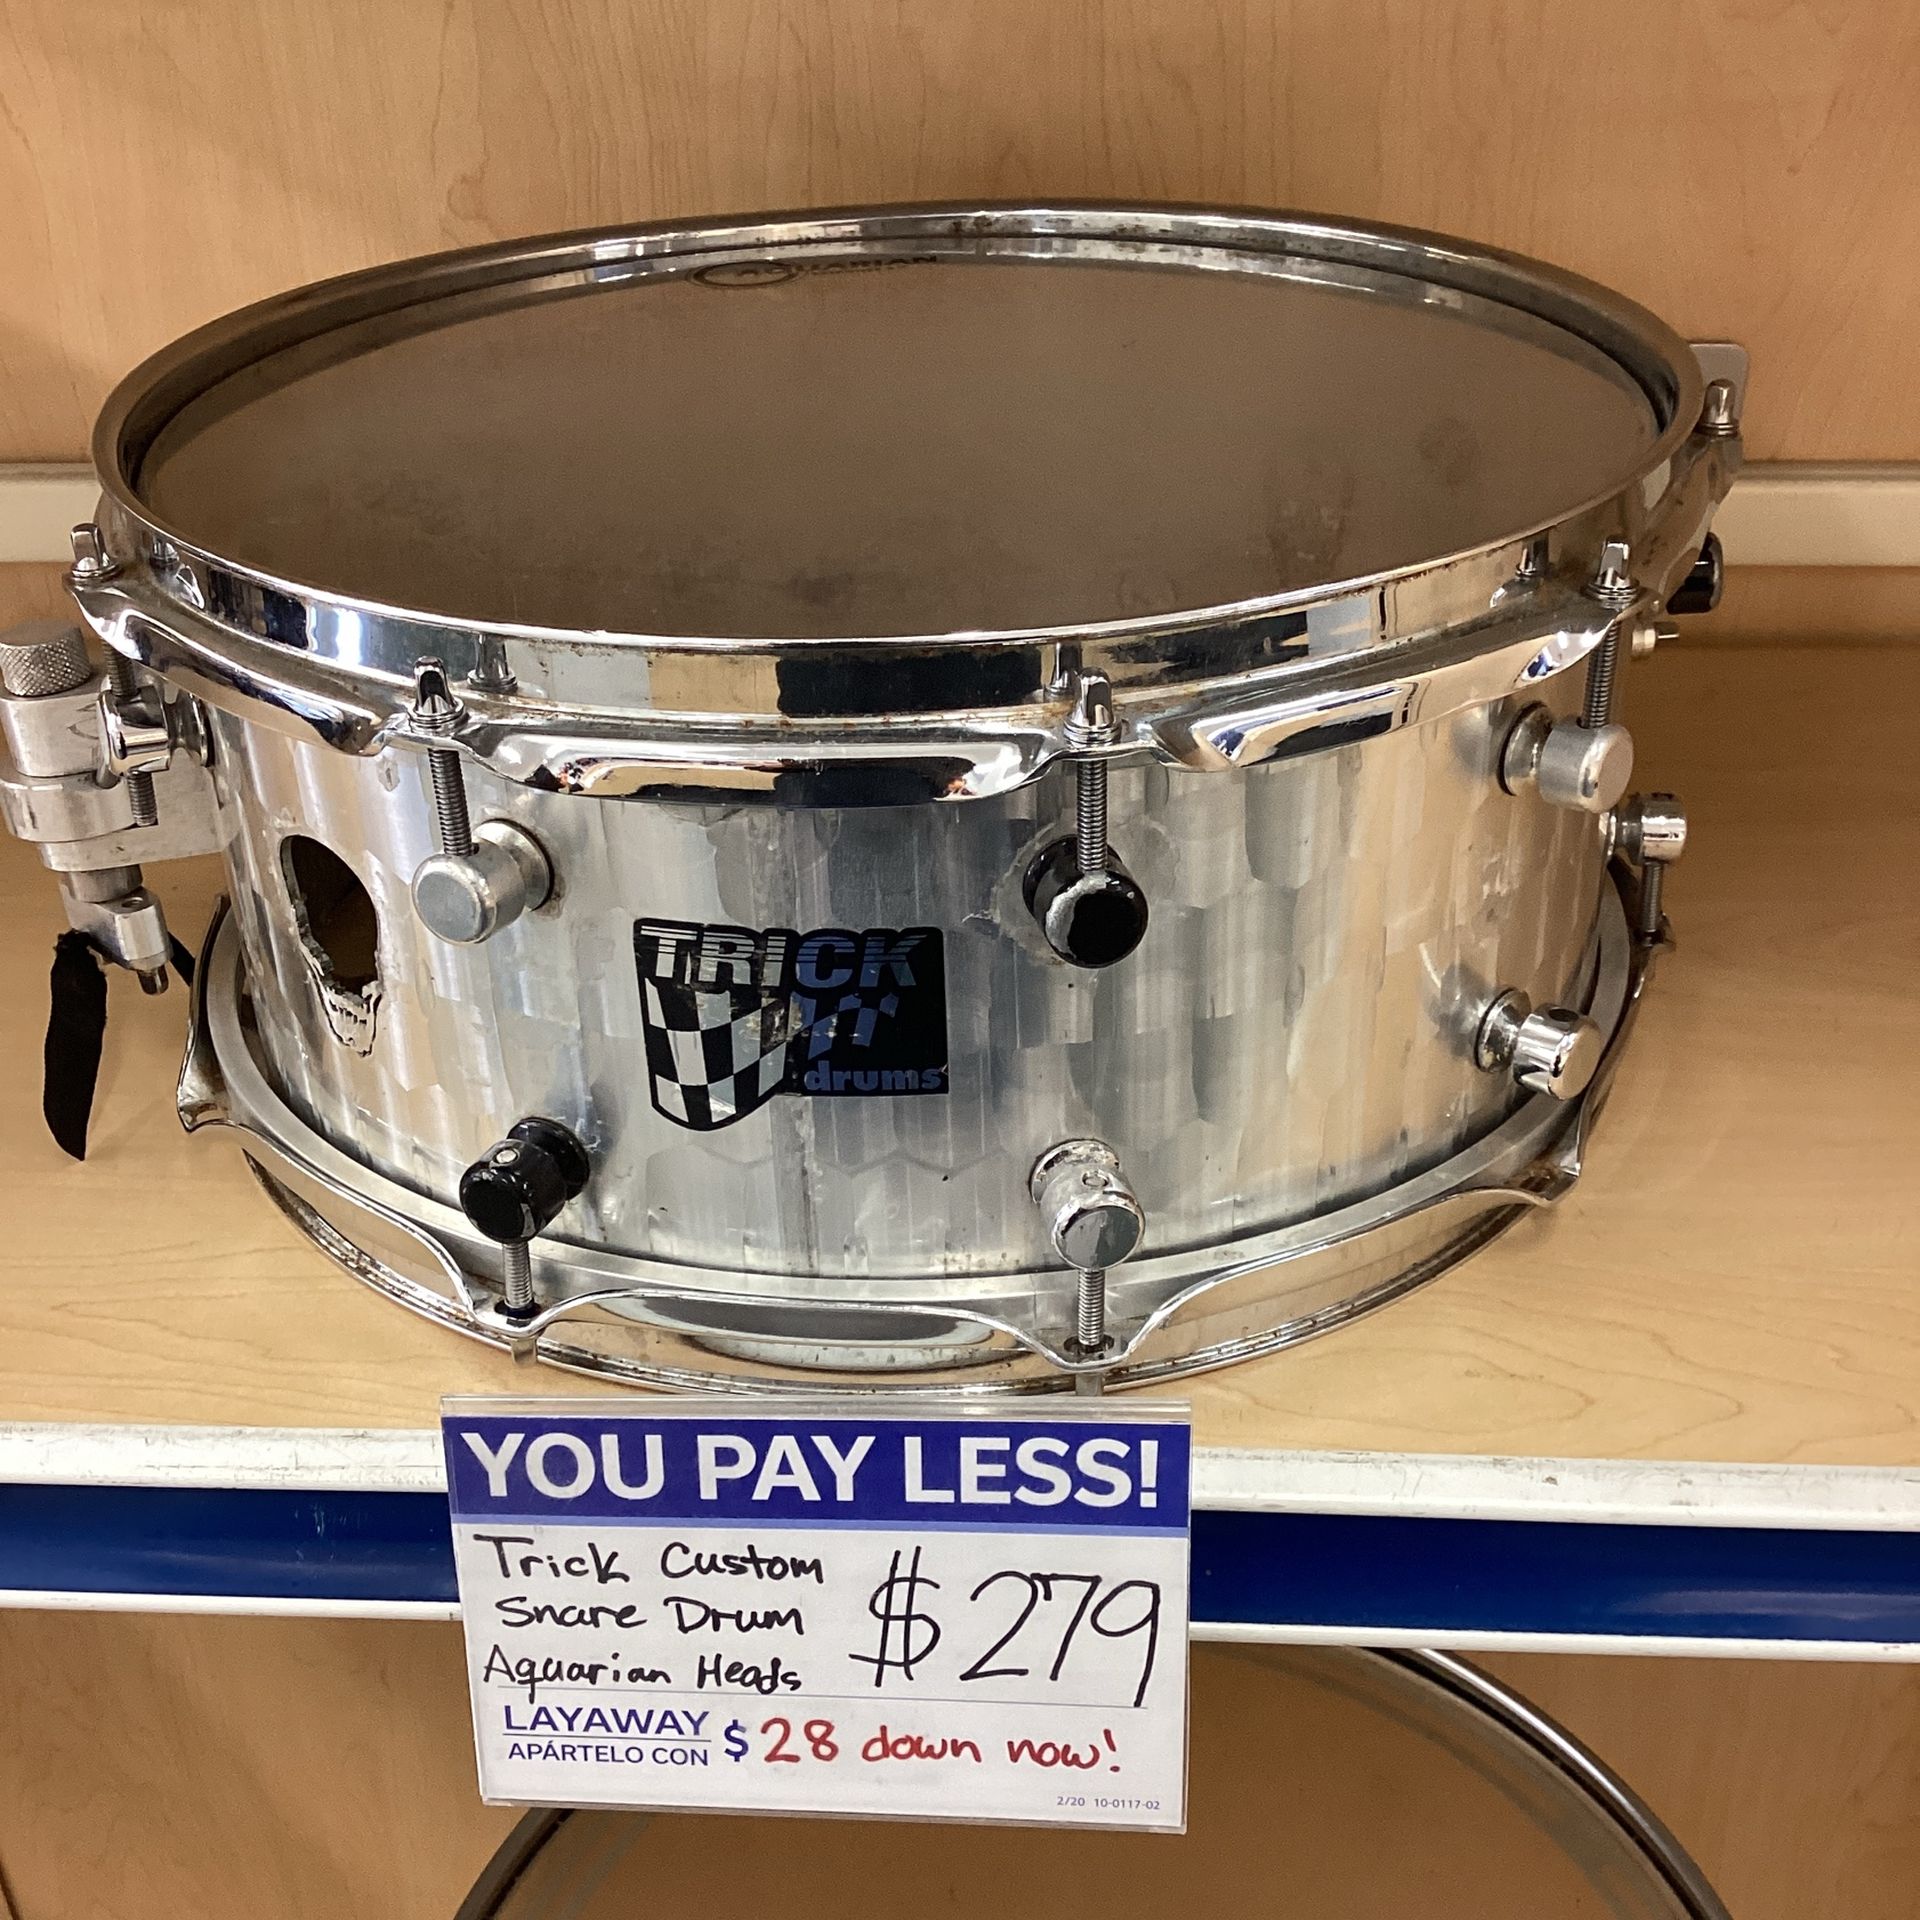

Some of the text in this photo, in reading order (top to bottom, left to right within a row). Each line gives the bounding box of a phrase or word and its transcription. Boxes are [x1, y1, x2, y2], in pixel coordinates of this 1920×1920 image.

[640, 925, 928, 988] TRICK
[804, 1060, 941, 1092] drums
[461, 1433, 1158, 1507] YOU PAY LESS!
[473, 1534, 823, 1584] Trick Custom
[495, 1597, 804, 1635] Snare Drum
[483, 1644, 802, 1704] Aquarian Heads
[503, 1704, 710, 1736] LAYAWAY
[507, 1741, 710, 1766] APÁRTELO CON
[861, 1725, 983, 1764] down
[1006, 1728, 1121, 1773] now!
[1056, 1796, 1161, 1810] 2/20 10-0117-02
